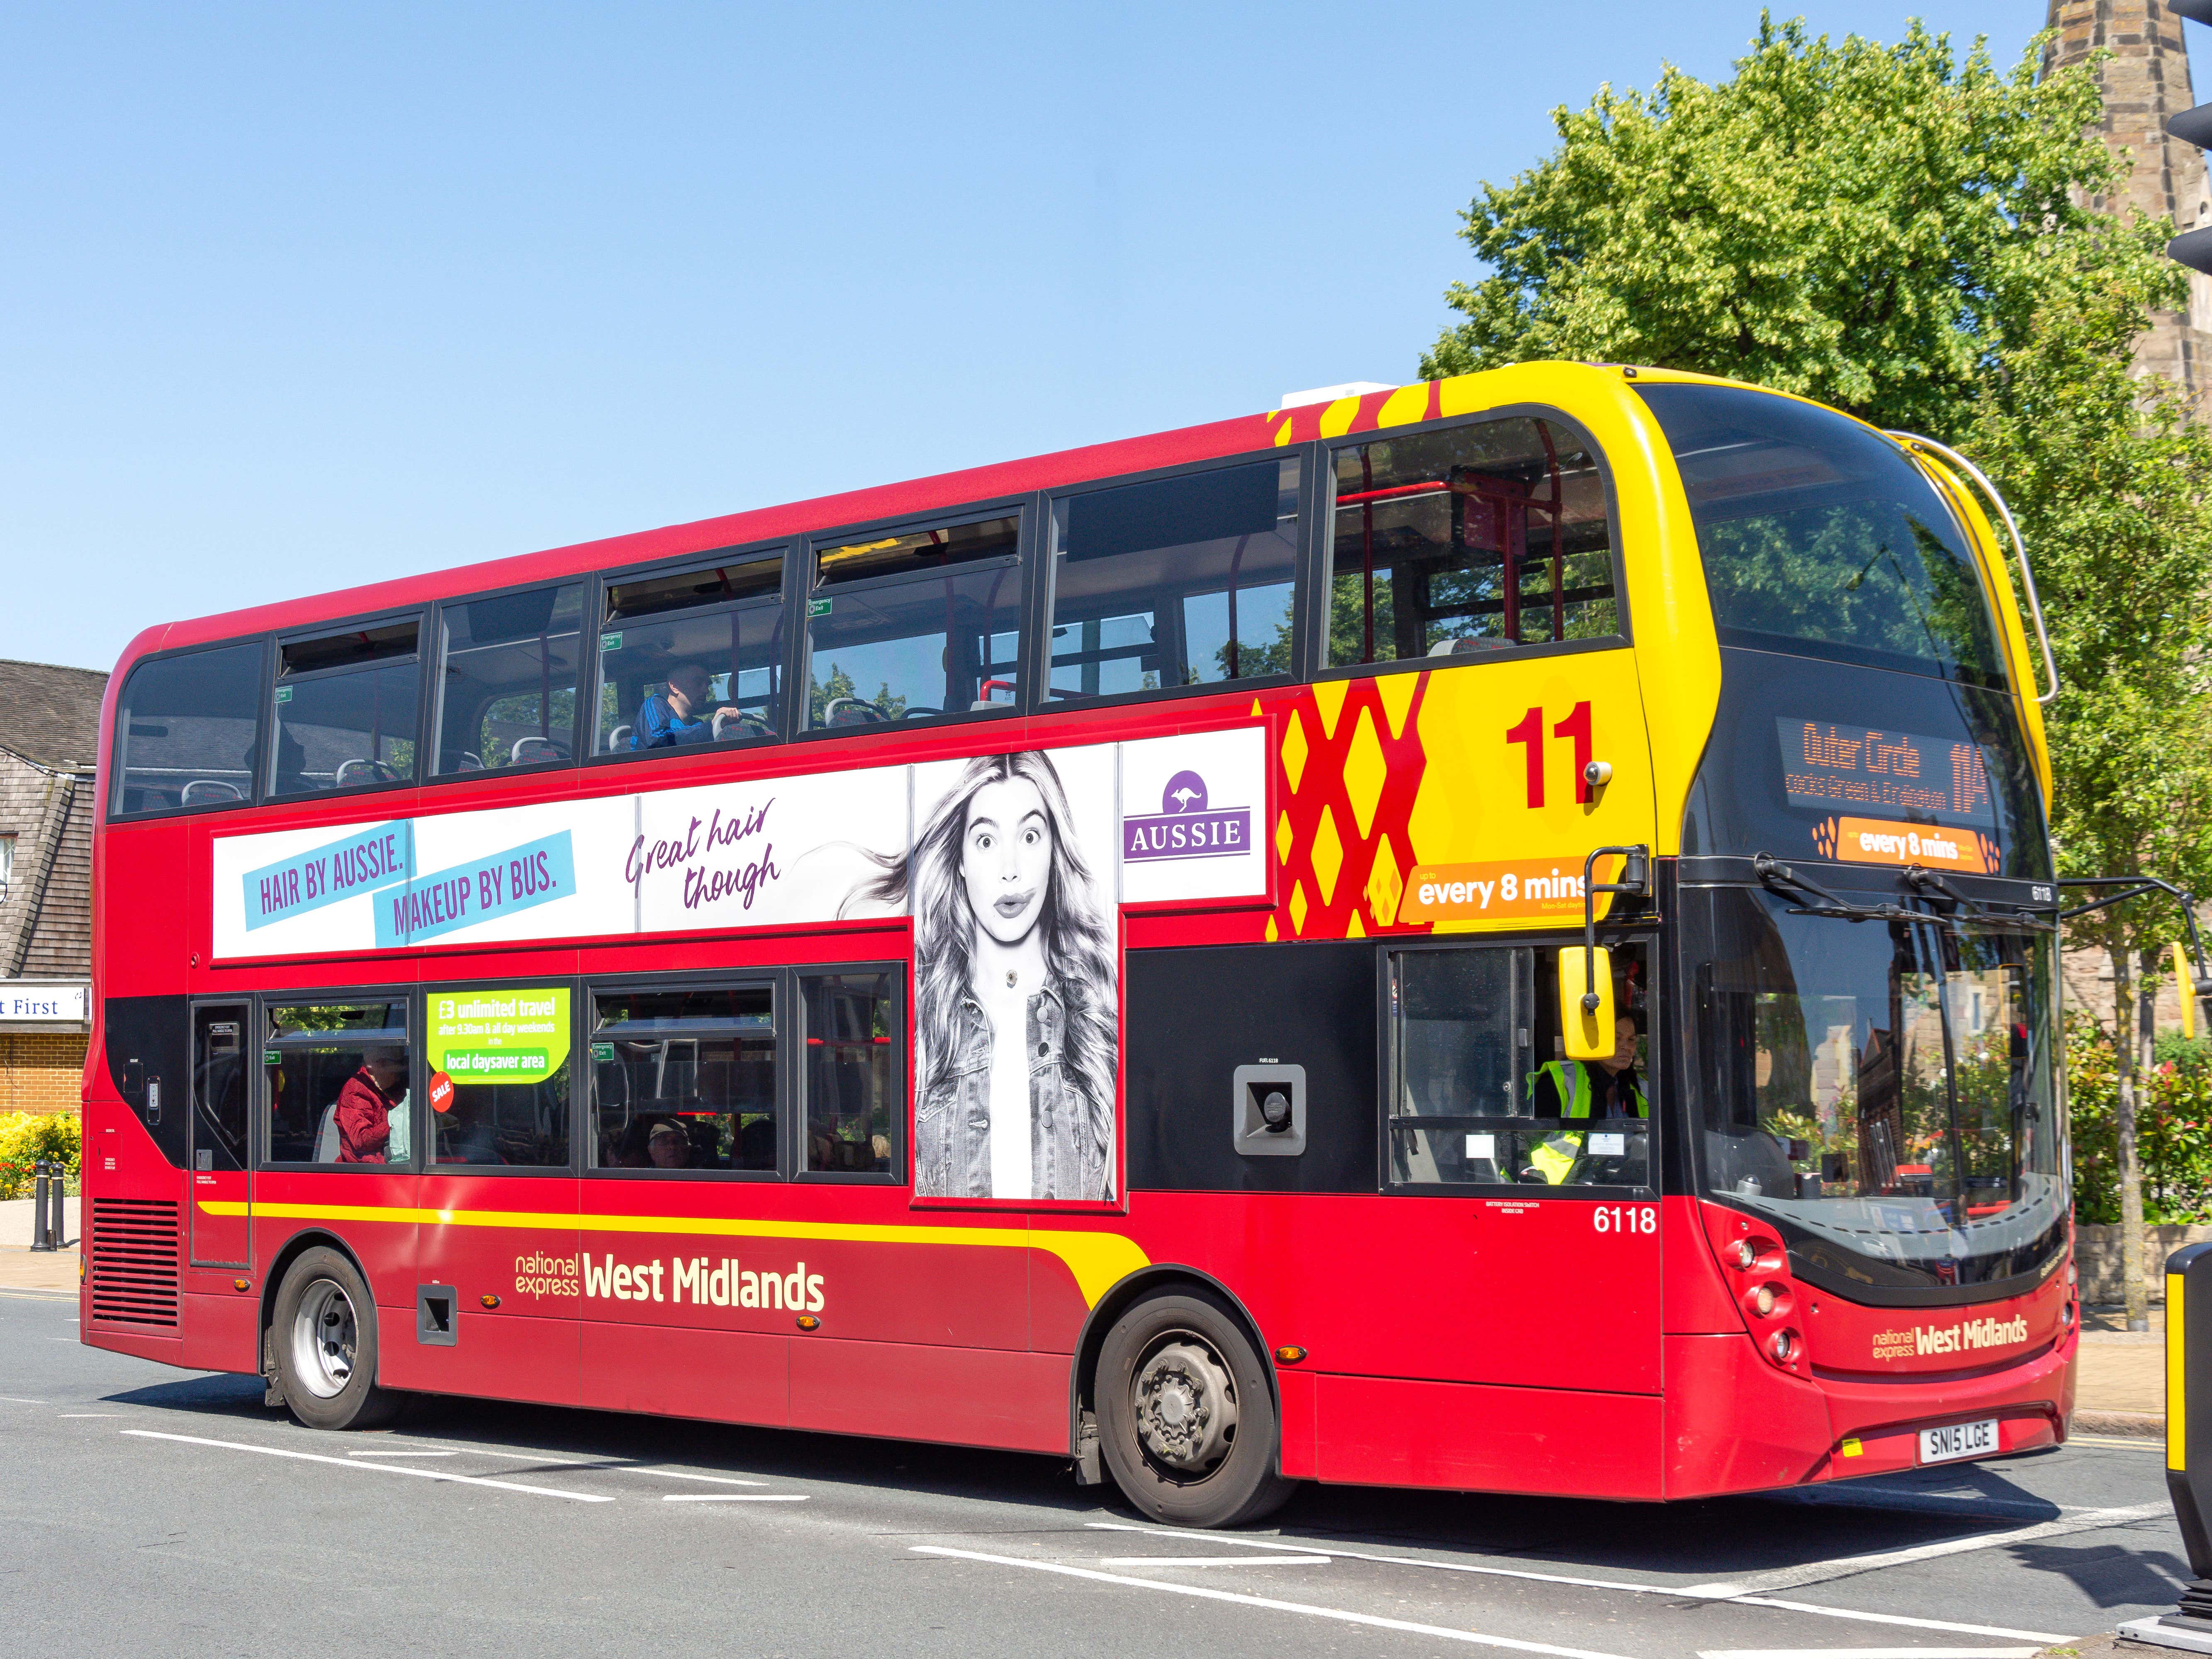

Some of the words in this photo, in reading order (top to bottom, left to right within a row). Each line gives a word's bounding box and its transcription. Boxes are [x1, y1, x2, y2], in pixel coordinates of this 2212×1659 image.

[1506, 701, 1594, 809] 11
[1803, 723, 1862, 770] Outer
[625, 816, 702, 899] Great
[706, 798, 776, 852] hair
[1131, 820, 1241, 851] AUSSIE
[1859, 832, 1906, 859] every
[1908, 832, 1920, 856] 8
[1921, 833, 1958, 859] mins
[260, 868, 300, 915] HAIR
[305, 857, 326, 900] BY
[333, 833, 403, 891] AUSSIE.
[684, 843, 781, 910] though
[393, 876, 471, 936] MAKEUP
[478, 865, 505, 910] BY
[511, 850, 557, 900] BUS.
[1419, 881, 1495, 909] every
[1501, 873, 1518, 900] 8
[2032, 886, 2051, 902] 6118
[14, 998, 58, 1014] First
[438, 1000, 455, 1019] £3
[458, 998, 516, 1018] unlimited
[518, 997, 555, 1016] travel
[438, 1024, 455, 1035] after
[457, 1023, 483, 1035] 9.30am
[485, 1023, 490, 1034] &
[492, 1022, 501, 1033] all
[502, 1022, 515, 1036] day
[517, 1021, 555, 1033] weekends
[447, 1053, 470, 1069] local
[472, 1053, 519, 1072] daysaver
[521, 1056, 545, 1068] area
[432, 1080, 451, 1102] SALE
[1594, 1207, 1656, 1233] 6118
[516, 1251, 579, 1275] national
[583, 1253, 664, 1301] West
[673, 1257, 825, 1312] Midlands
[516, 1276, 579, 1300] express
[1873, 1328, 1914, 1345] national
[1915, 1326, 1961, 1355] West
[1964, 1314, 2027, 1350] Midlands
[1873, 1345, 1915, 1362] express
[1931, 1428, 1961, 1455] SN15
[1965, 1423, 1989, 1449] LGE
